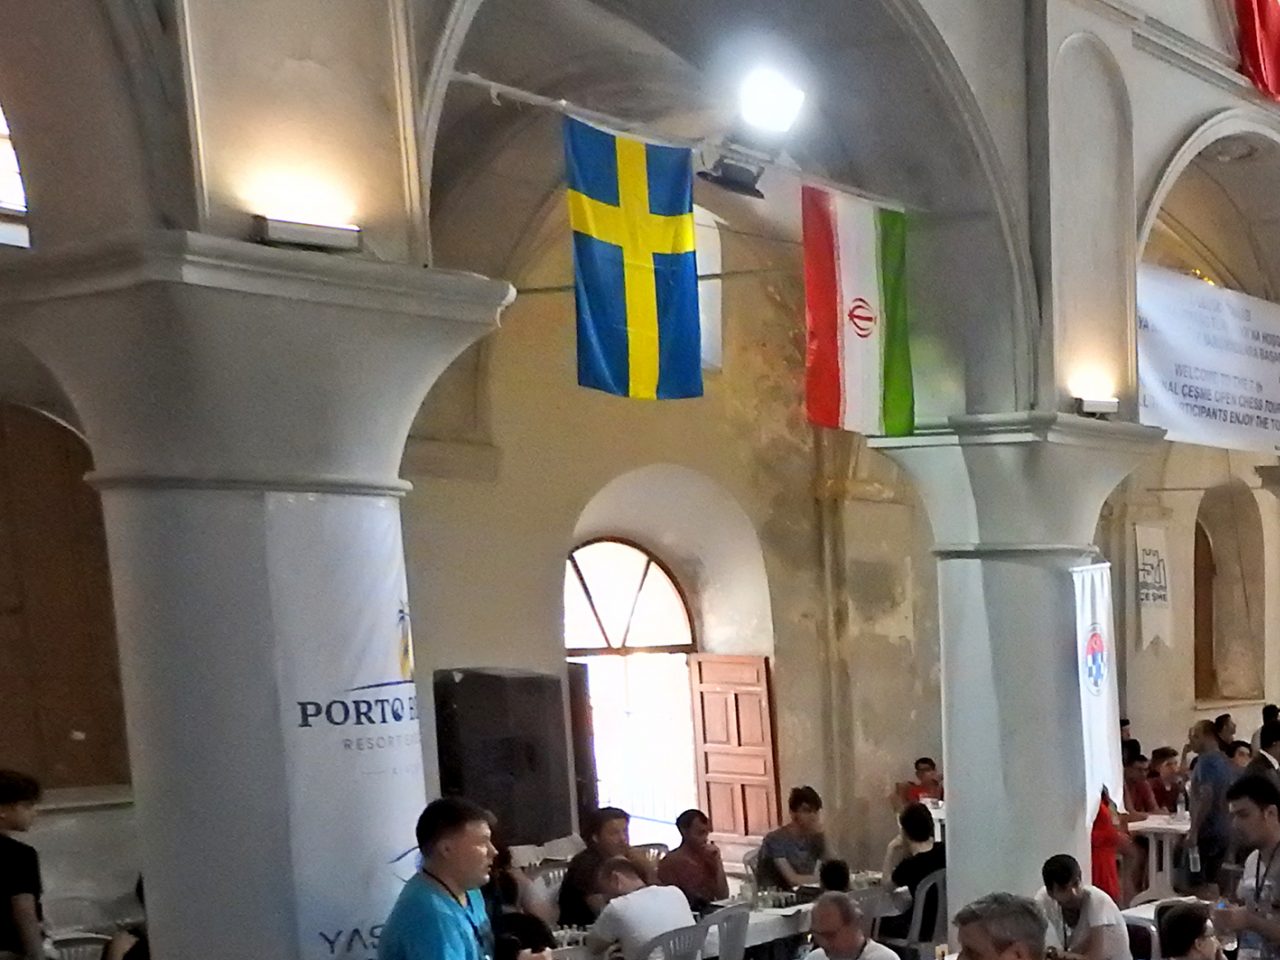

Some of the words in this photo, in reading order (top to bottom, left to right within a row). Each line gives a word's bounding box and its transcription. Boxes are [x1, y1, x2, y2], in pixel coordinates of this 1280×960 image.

[1238, 395, 1263, 412] CHESS
[1230, 411, 1255, 427] ENJOY
[1256, 415, 1270, 430] THE
[296, 698, 404, 728] PORTO
